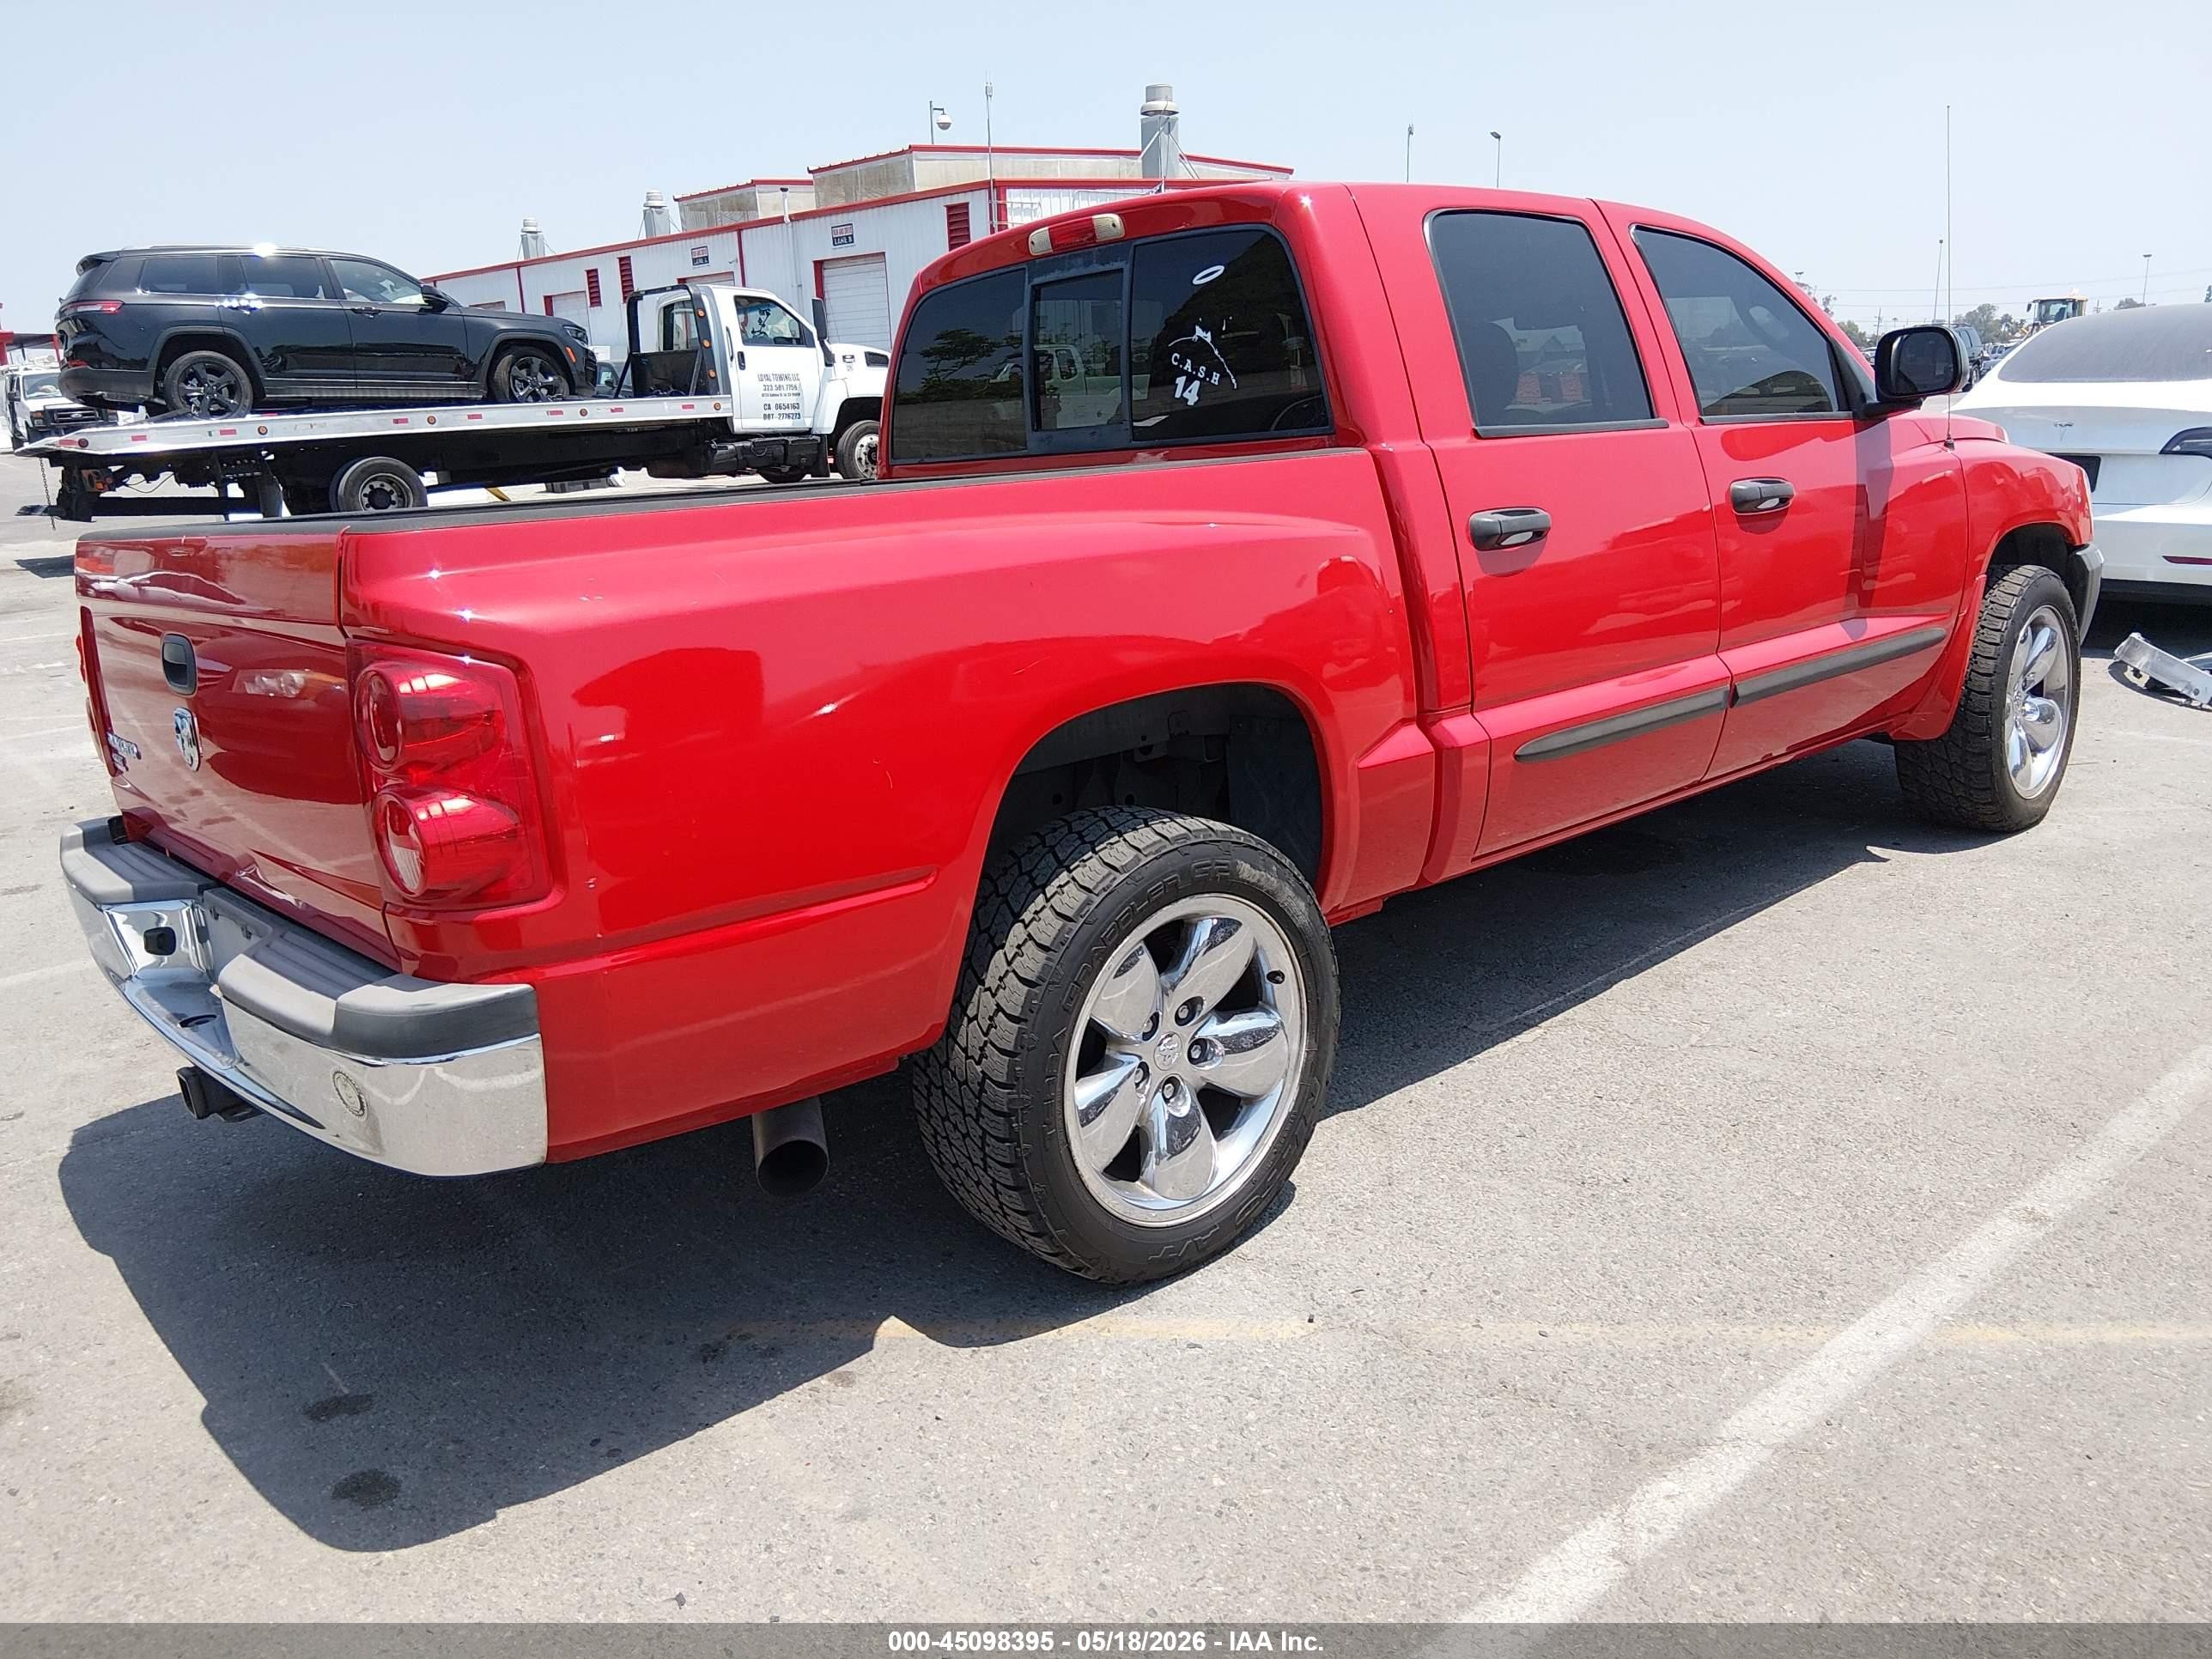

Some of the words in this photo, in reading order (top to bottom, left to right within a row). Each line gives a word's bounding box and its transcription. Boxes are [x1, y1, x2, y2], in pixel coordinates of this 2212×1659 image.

[757, 373, 772, 382] LOYAL
[772, 373, 792, 382] TOWING
[792, 373, 800, 381] LLC
[1174, 375, 1200, 405] 14
